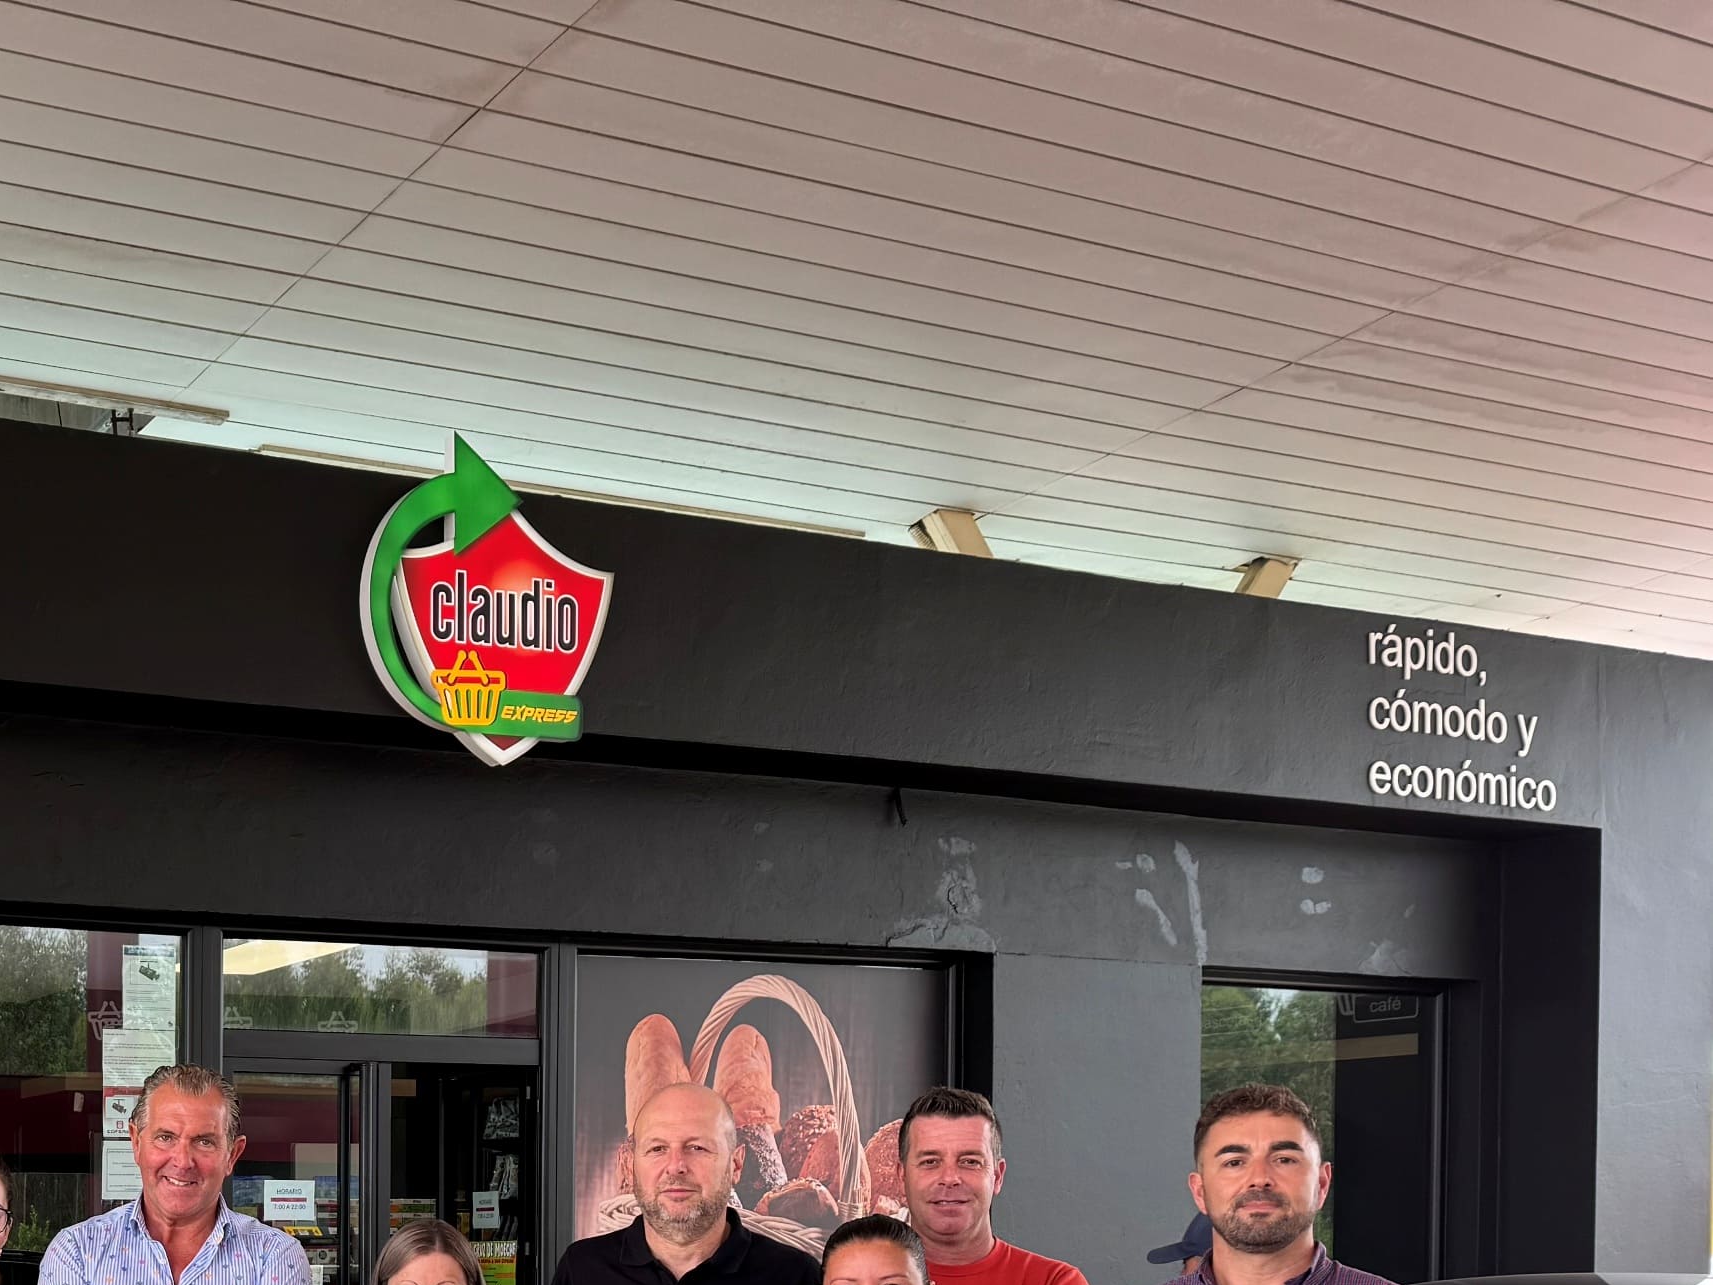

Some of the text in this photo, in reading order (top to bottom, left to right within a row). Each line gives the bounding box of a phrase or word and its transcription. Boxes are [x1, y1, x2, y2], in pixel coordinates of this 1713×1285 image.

[430, 569, 578, 654] claudio
[1368, 624, 1486, 686] rápido,
[500, 704, 578, 723] EXPRESS
[1369, 689, 1538, 757] cómodo y
[1369, 760, 1557, 811] económico
[1369, 996, 1402, 1013] café
